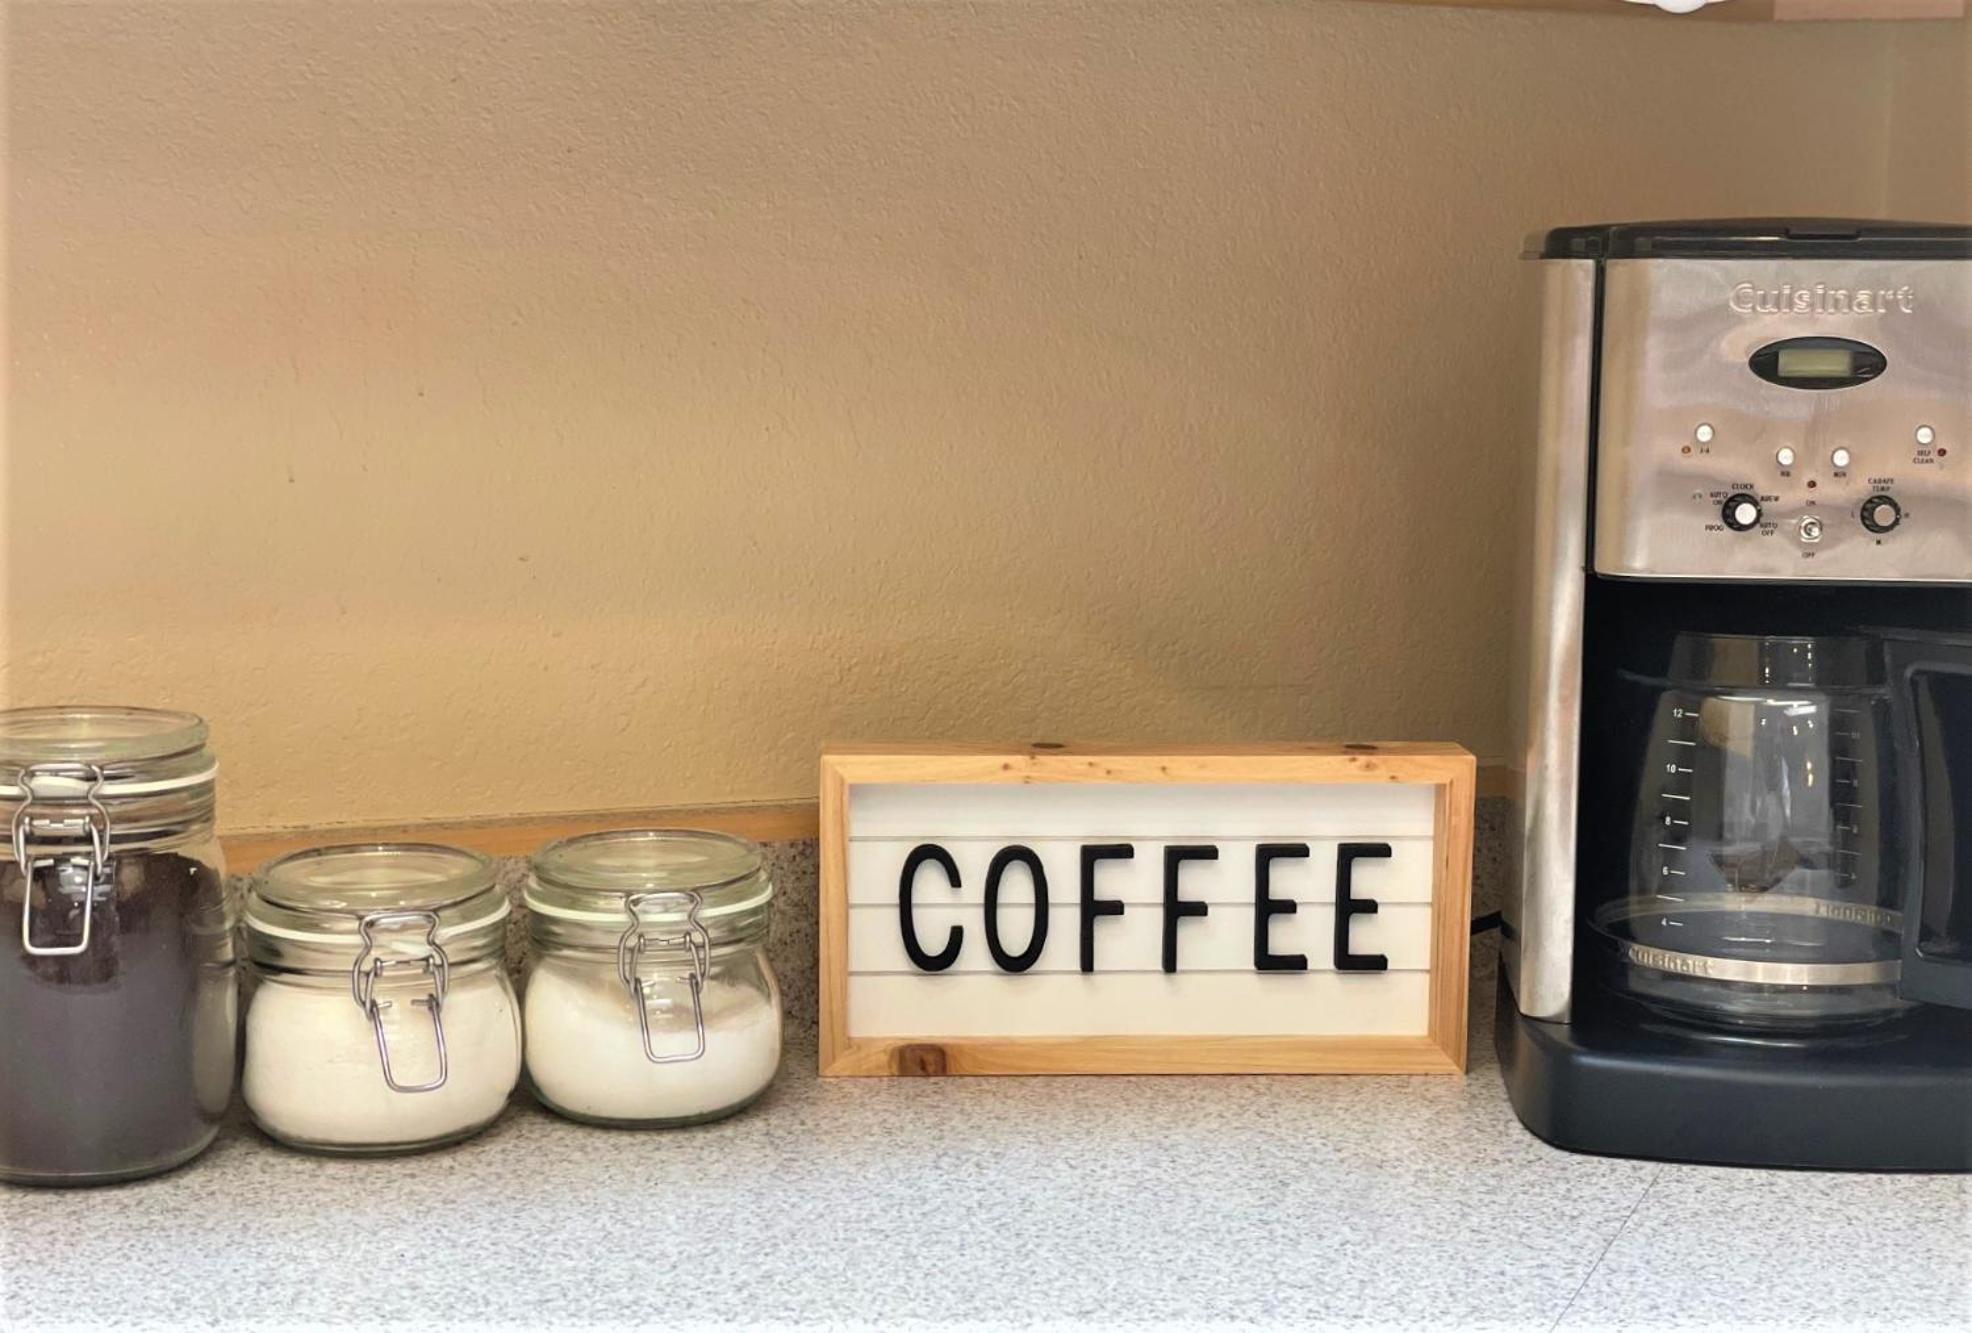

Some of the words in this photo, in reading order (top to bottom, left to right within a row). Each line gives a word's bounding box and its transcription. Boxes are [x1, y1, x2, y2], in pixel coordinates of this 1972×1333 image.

[1729, 282, 1915, 314] Cuisinart
[1731, 482, 1755, 490] CLOCK
[1672, 708, 1683, 718] 12
[1666, 764, 1676, 773] 10
[1664, 816, 1671, 826] 8
[1662, 866, 1669, 876] 6
[898, 843, 1393, 974] COFFEE
